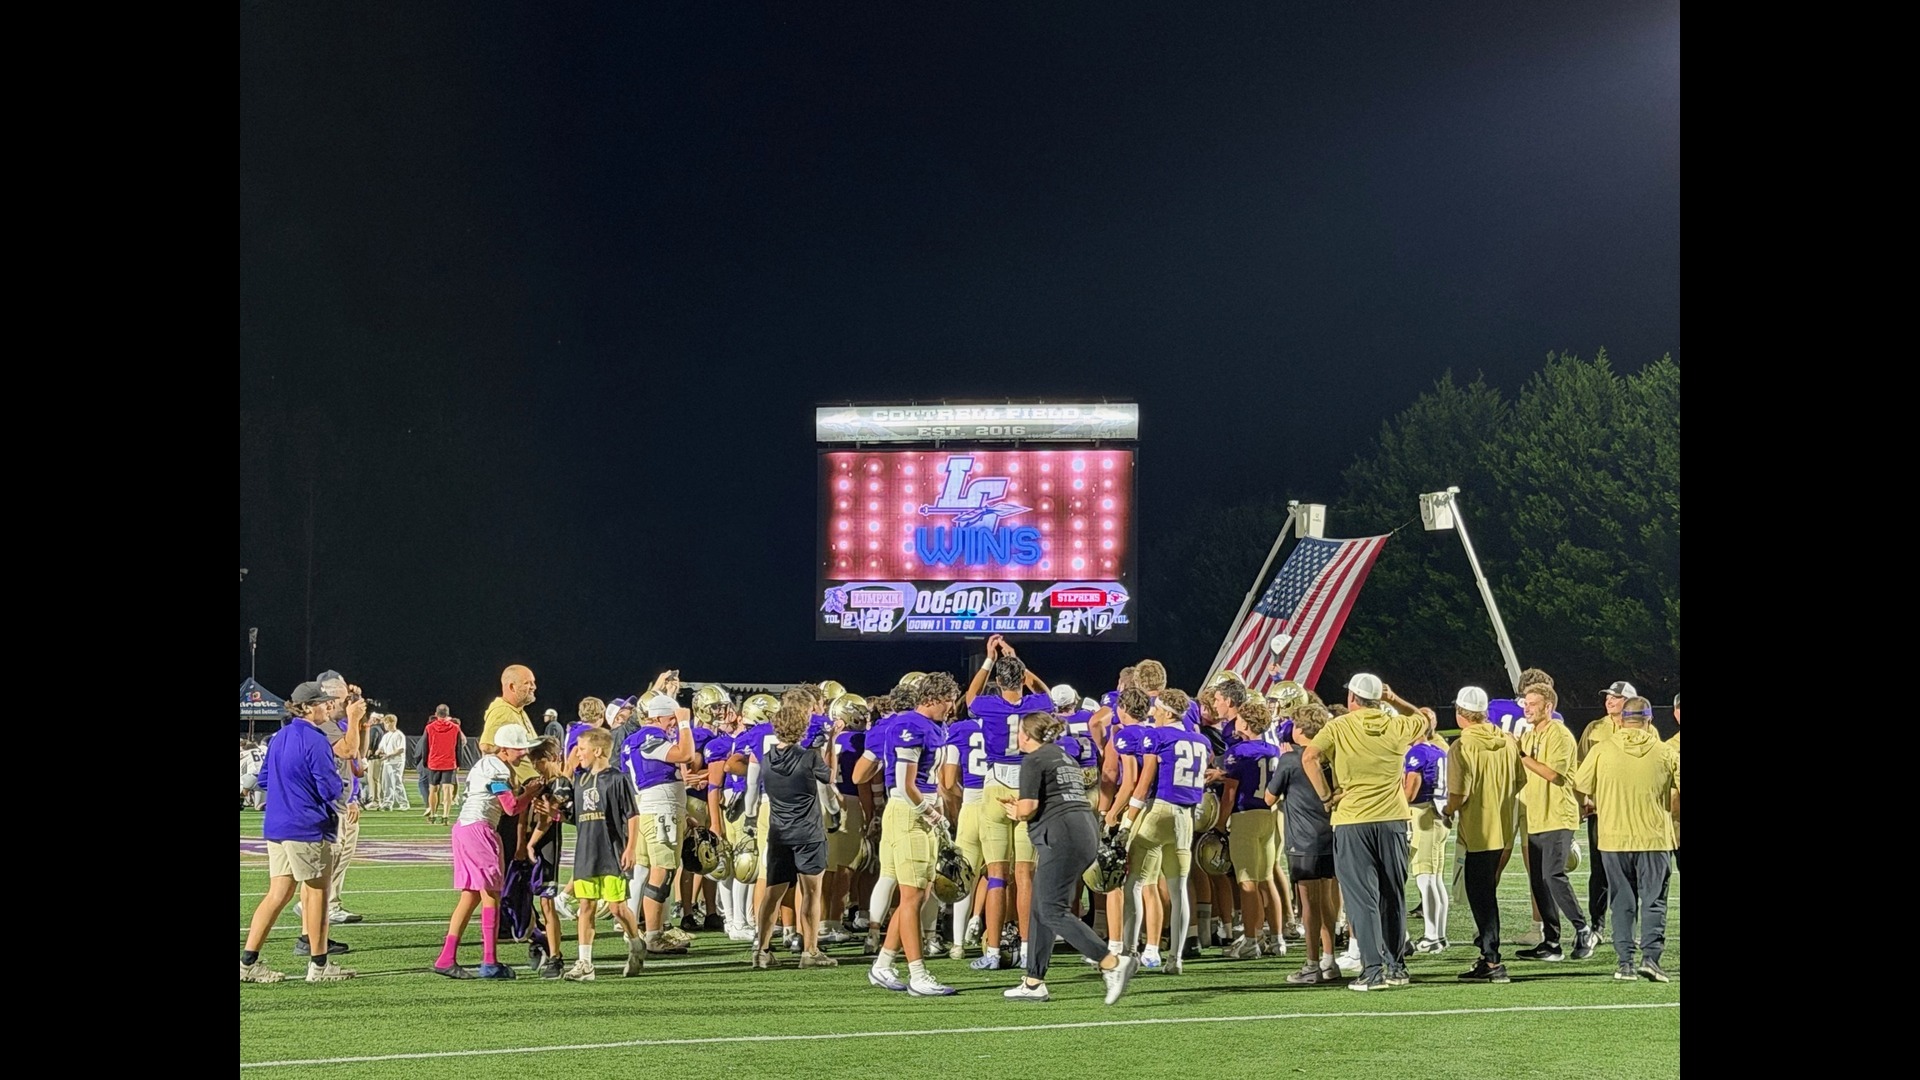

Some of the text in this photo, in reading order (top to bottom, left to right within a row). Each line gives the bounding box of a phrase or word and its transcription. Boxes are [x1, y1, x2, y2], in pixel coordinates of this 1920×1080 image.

[872, 407, 1080, 421] COTTRELL FIELD
[917, 425, 1026, 437] EST. 2016
[915, 526, 1042, 566] WINS
[854, 593, 899, 605] LUMPKIN
[915, 590, 984, 614] 00:00
[991, 591, 1043, 613] QTR 4
[1057, 593, 1100, 603] STEPHENS
[824, 614, 840, 624] TOL
[863, 608, 895, 632] 28
[908, 620, 941, 631] DOWN 1
[950, 620, 961, 630] TO
[962, 620, 976, 630] GO
[995, 620, 1044, 630] BALL ON 10
[1056, 609, 1082, 634] 21
[1098, 614, 1108, 628] 0
[1173, 740, 1208, 788] 27
